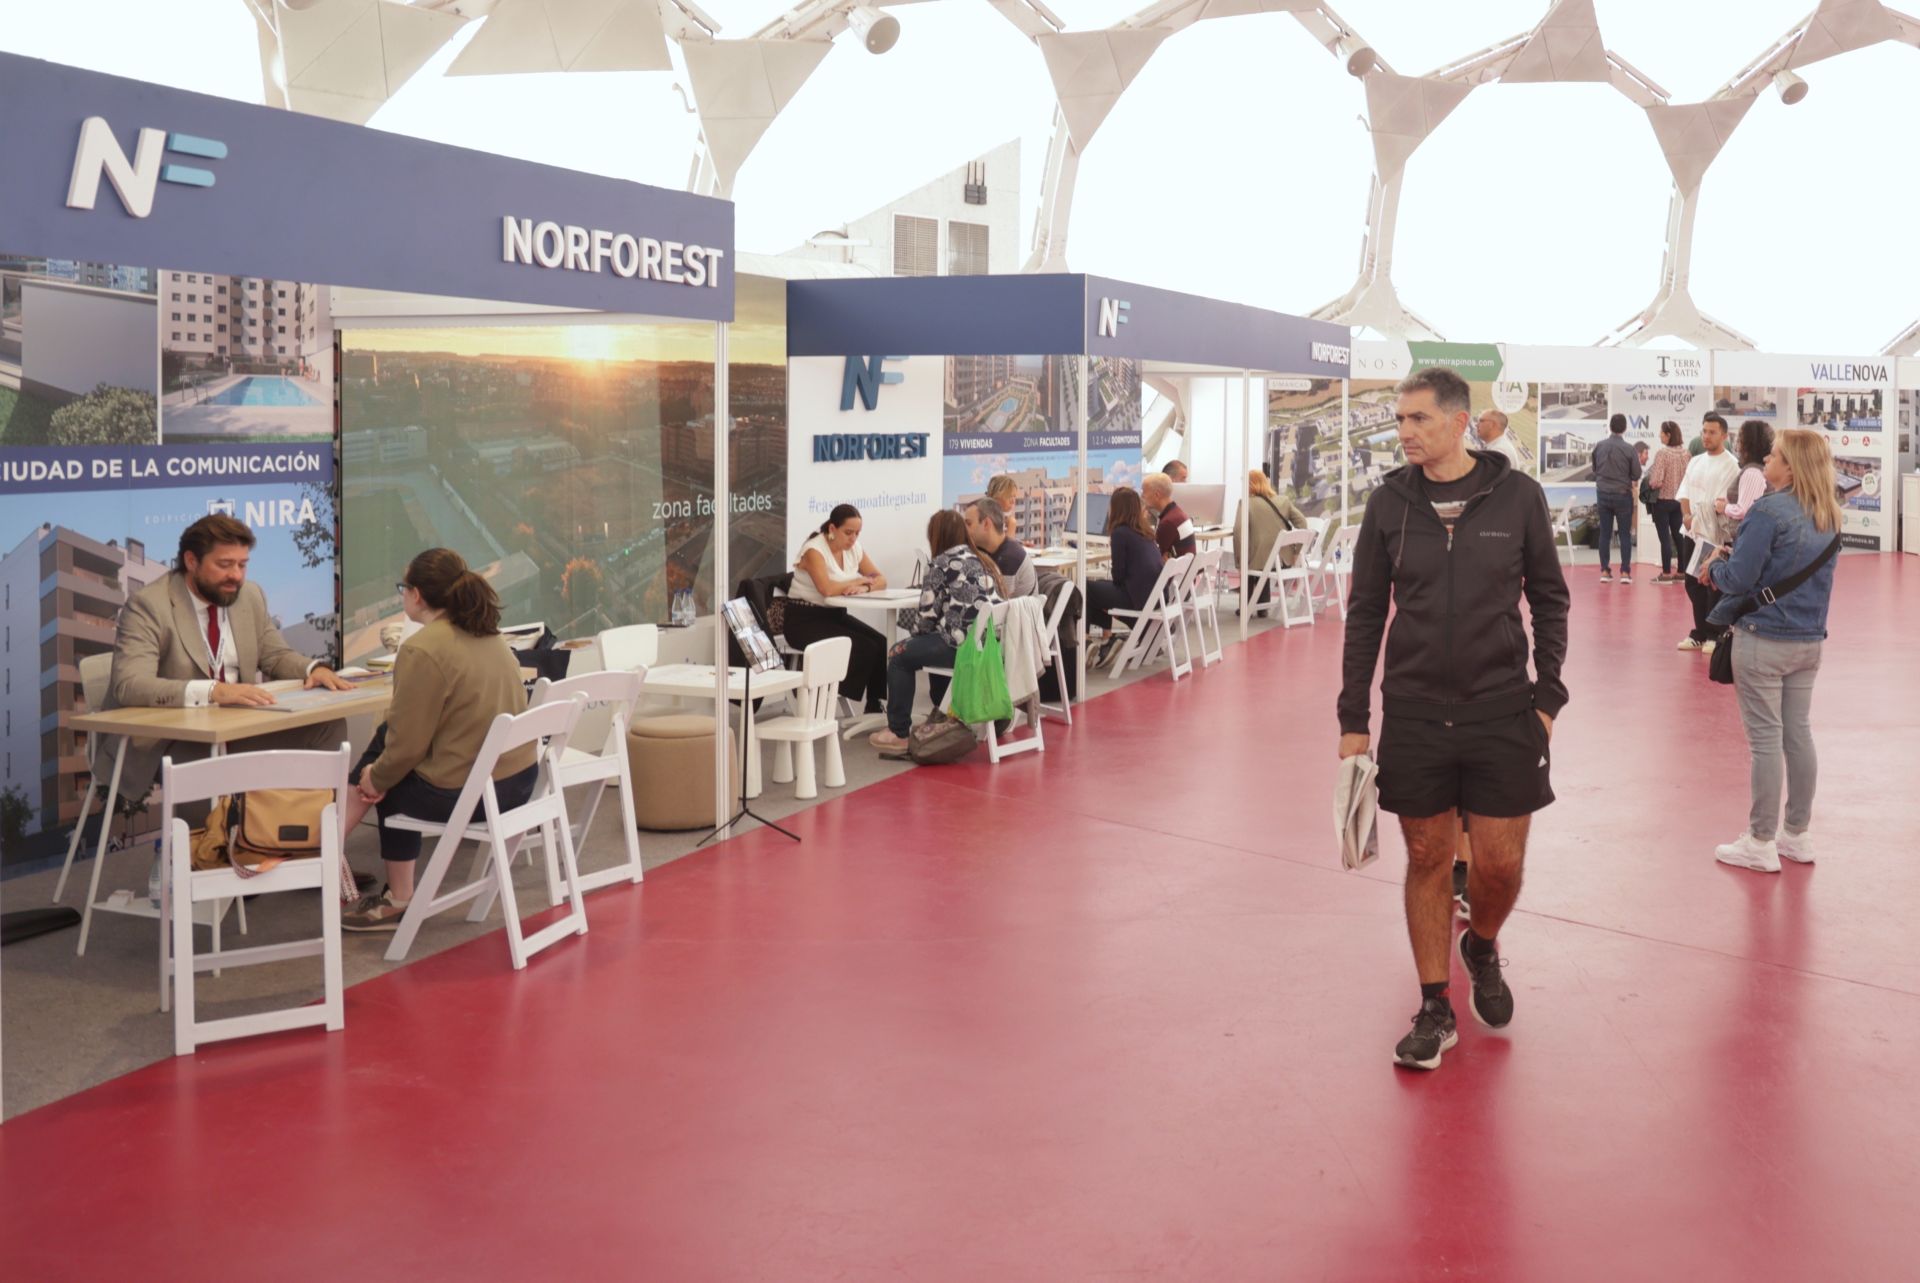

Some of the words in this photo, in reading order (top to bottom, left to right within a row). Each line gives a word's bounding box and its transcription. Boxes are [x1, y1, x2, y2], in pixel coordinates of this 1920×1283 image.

[65, 116, 228, 218] NF
[503, 215, 724, 288] NORFOREST
[1098, 296, 1131, 338] NF
[1311, 341, 1350, 365] NORFOREST
[1417, 357, 1494, 368] www.mirapinos.com
[1673, 359, 1701, 369] TERRA
[1675, 368, 1699, 377] SATIS
[1811, 363, 1888, 382] VALLENOVA
[1668, 389, 1696, 413] hogar
[1628, 414, 1650, 430] VN
[813, 432, 930, 463] NORFOREST
[959, 438, 993, 449] VIVIENDAS
[1023, 437, 1039, 448] ZONA
[1039, 436, 1070, 447] FACULTADES
[0, 460, 83, 482] IUDAD
[92, 459, 123, 479] DE
[131, 457, 160, 478] LA
[166, 451, 320, 476] COMUNICACIÓN
[245, 498, 317, 527] NIRA
[652, 500, 691, 520] zona
[696, 490, 772, 516] facltades
